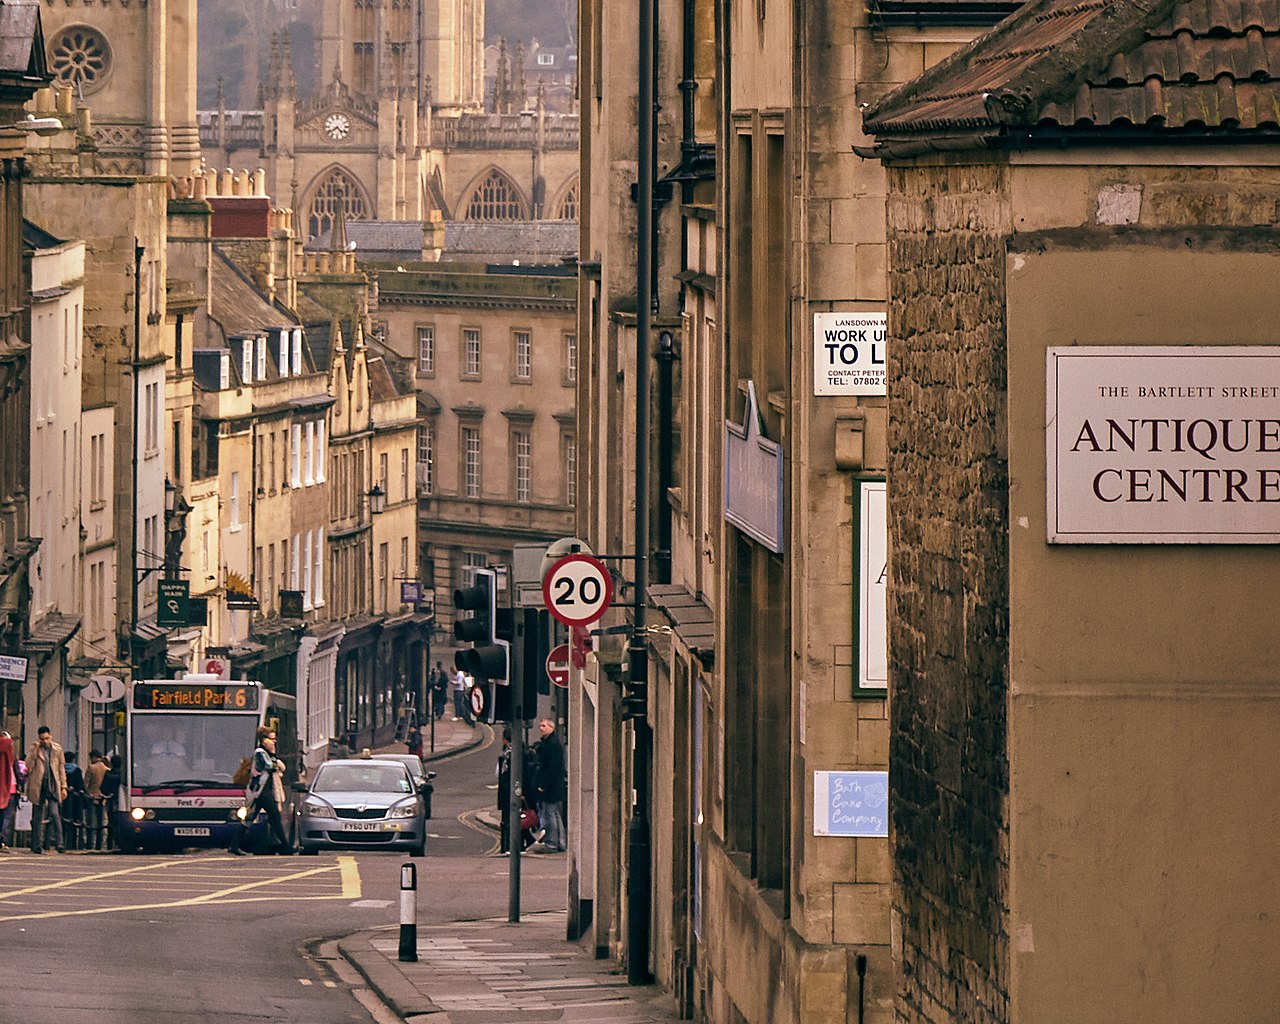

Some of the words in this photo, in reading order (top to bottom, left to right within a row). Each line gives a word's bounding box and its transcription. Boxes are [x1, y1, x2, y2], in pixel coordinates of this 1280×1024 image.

[824, 330, 867, 342] WORK
[824, 343, 858, 365] TO
[827, 377, 849, 385] TEL:
[853, 377, 880, 385] 07802
[1098, 386, 1129, 398] THE
[1138, 386, 1215, 398] BARTLETT
[1221, 386, 1280, 398] STREET
[1070, 419, 1280, 461] ANTIQUE
[1092, 468, 1280, 503] CENTRE
[554, 576, 601, 605] 20
[151, 689, 201, 707] Fairfield
[204, 688, 232, 707] Park
[235, 689, 246, 707] 6
[832, 777, 862, 794] Bath
[344, 822, 363, 830] FY60
[364, 822, 377, 831] UTF
[832, 808, 882, 832] Company
